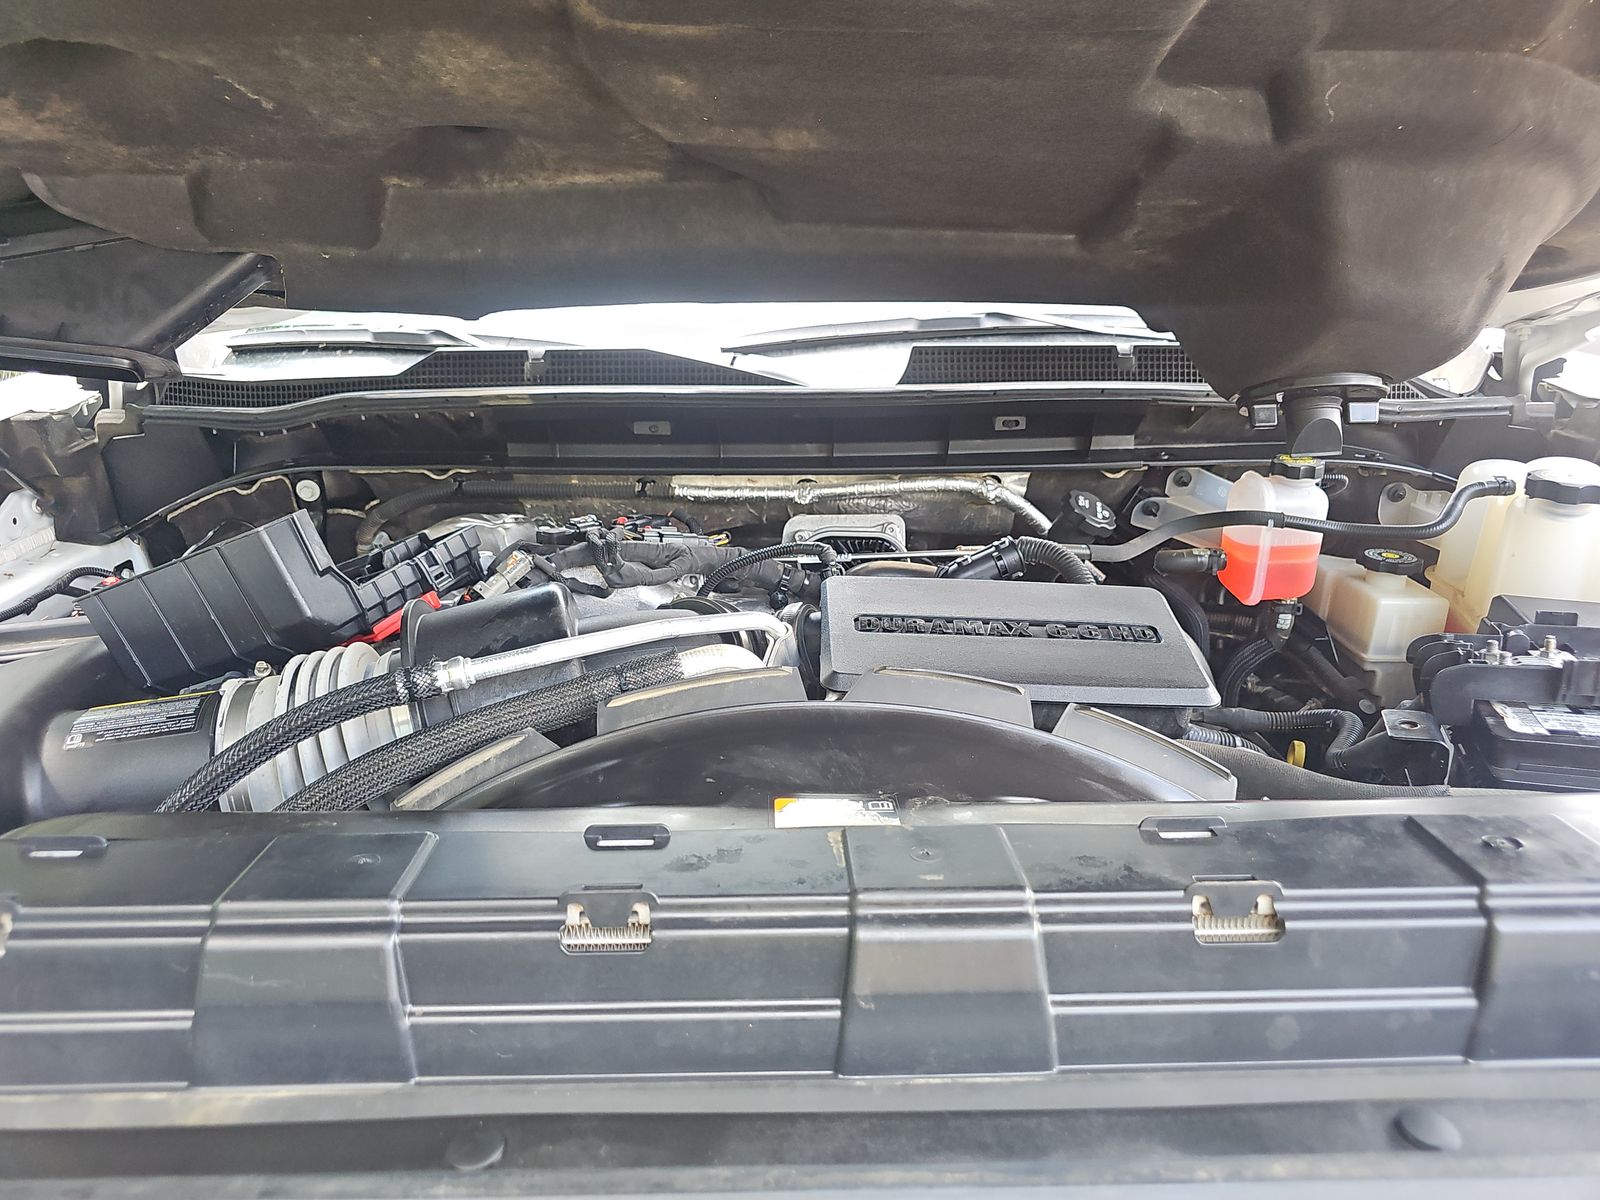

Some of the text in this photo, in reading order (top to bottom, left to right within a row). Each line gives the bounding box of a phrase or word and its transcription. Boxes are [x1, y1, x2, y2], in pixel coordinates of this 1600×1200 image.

[858, 616, 1157, 642] DURAMAX 6.6 HD
